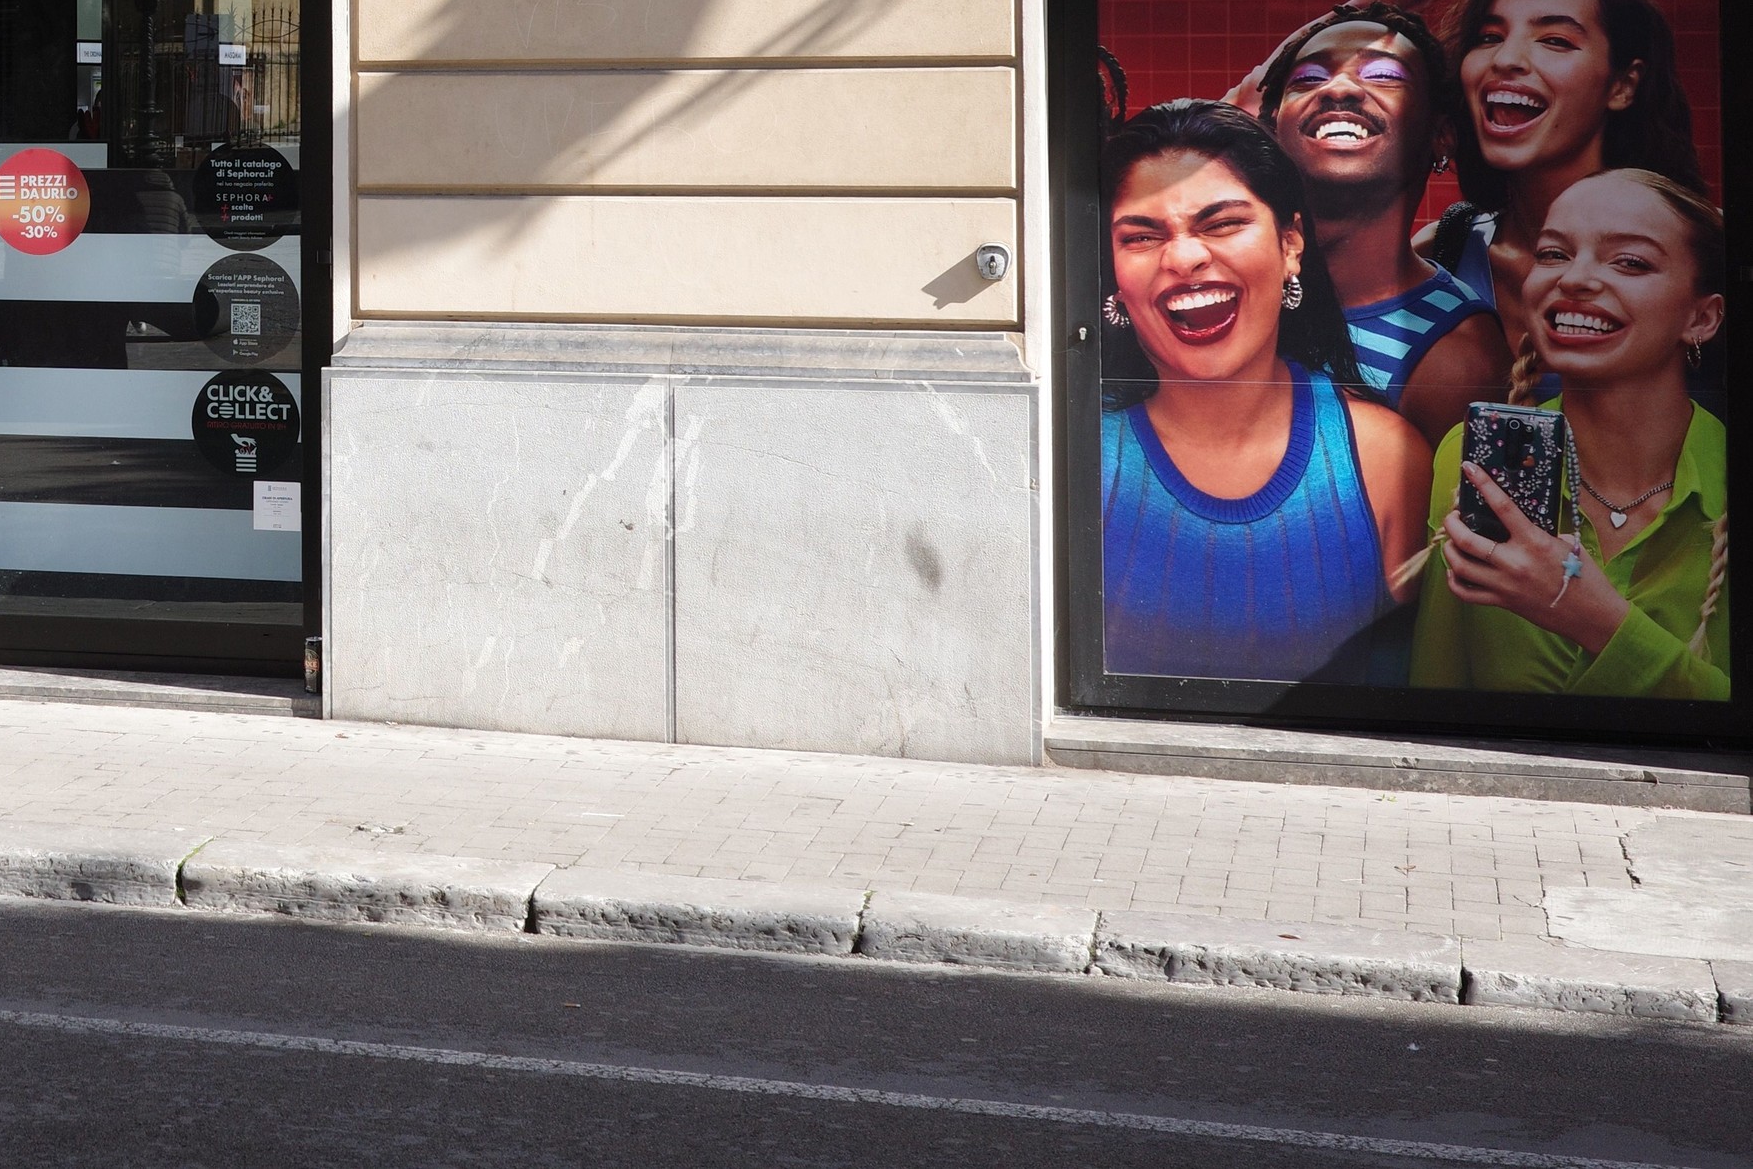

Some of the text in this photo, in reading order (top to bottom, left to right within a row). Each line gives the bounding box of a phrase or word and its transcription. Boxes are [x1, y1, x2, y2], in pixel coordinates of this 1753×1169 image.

[210, 159, 282, 170] Tutto il catalogo
[20, 174, 67, 187] PREZZI
[216, 169, 274, 180] di Sephora.it
[20, 187, 78, 200] DA URLO
[231, 203, 254, 211] scelta
[12, 205, 65, 223] -50%
[231, 213, 264, 223] prodotti
[20, 225, 58, 239] -30%
[207, 273, 232, 281] Scarica
[253, 274, 285, 283] Sephora!
[206, 384, 274, 403] CLICK&
[206, 402, 291, 420] COLLECT
